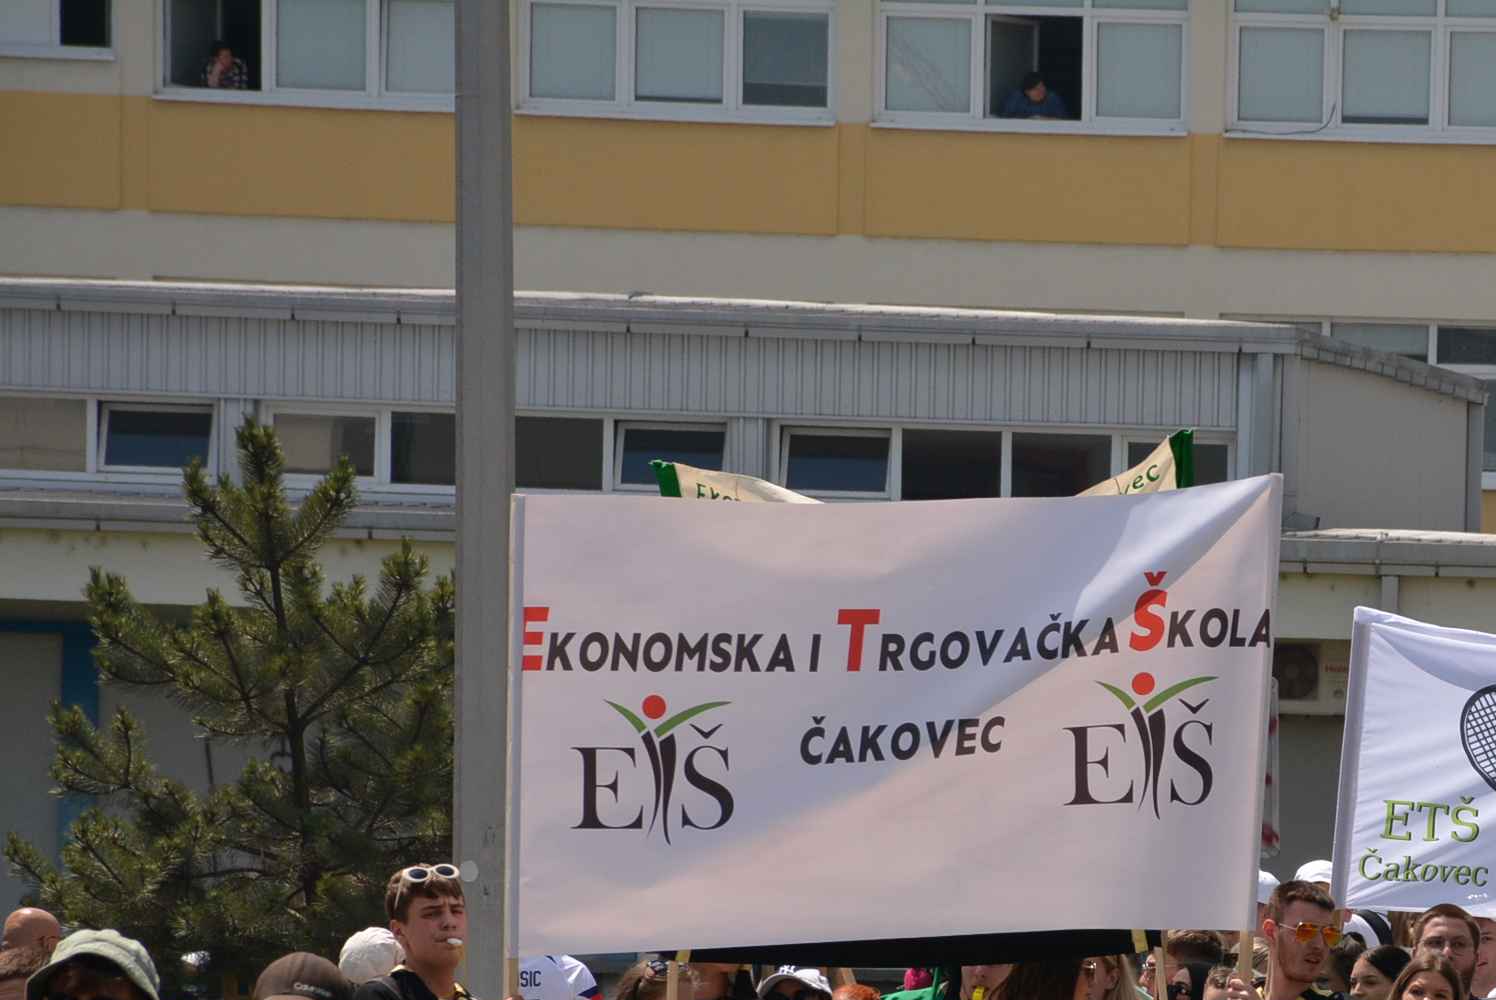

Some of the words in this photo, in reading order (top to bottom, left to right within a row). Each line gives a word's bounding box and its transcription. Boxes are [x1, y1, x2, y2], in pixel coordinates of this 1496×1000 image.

[522, 606, 797, 672] EKONOMSKA
[808, 633, 822, 672] I
[837, 607, 1120, 672] TRGOVAČKA
[1129, 571, 1271, 652] ŠKOLA
[800, 715, 1006, 766] ČAKOVEC
[1381, 796, 1480, 842] ETŠ
[1359, 848, 1489, 887] Čakovec
